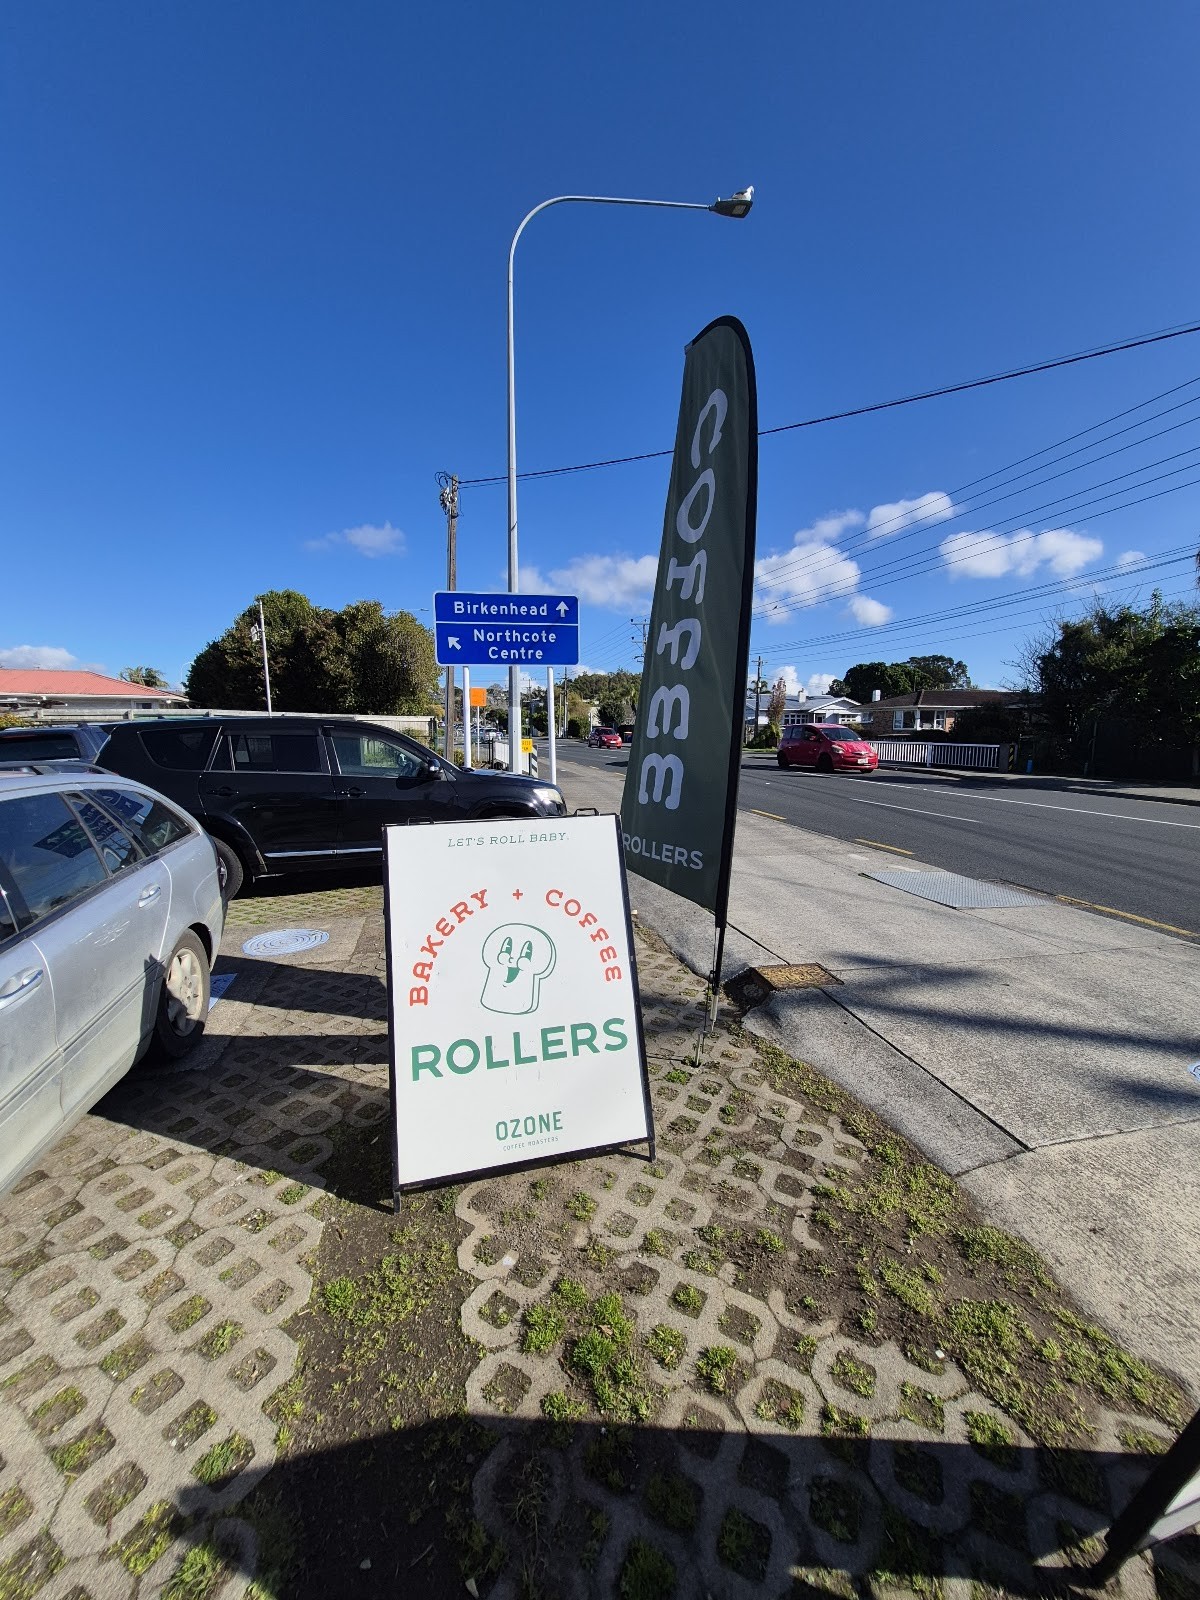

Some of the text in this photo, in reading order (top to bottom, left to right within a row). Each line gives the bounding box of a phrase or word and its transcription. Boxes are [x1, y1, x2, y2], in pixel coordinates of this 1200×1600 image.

[453, 601, 548, 616] Birkenhead
[638, 388, 728, 810] COFFEE
[473, 628, 557, 643] Northcote
[488, 646, 544, 660] Centre
[447, 836, 485, 848] LET'S
[489, 834, 525, 845] ROLL
[623, 832, 704, 870] ROLLERS
[409, 888, 489, 1007] BAKERY
[545, 888, 622, 983] COFFEE
[411, 1017, 629, 1082] ROLLERS
[495, 1110, 563, 1142] OZONE
[502, 1142, 526, 1152] COFFEE
